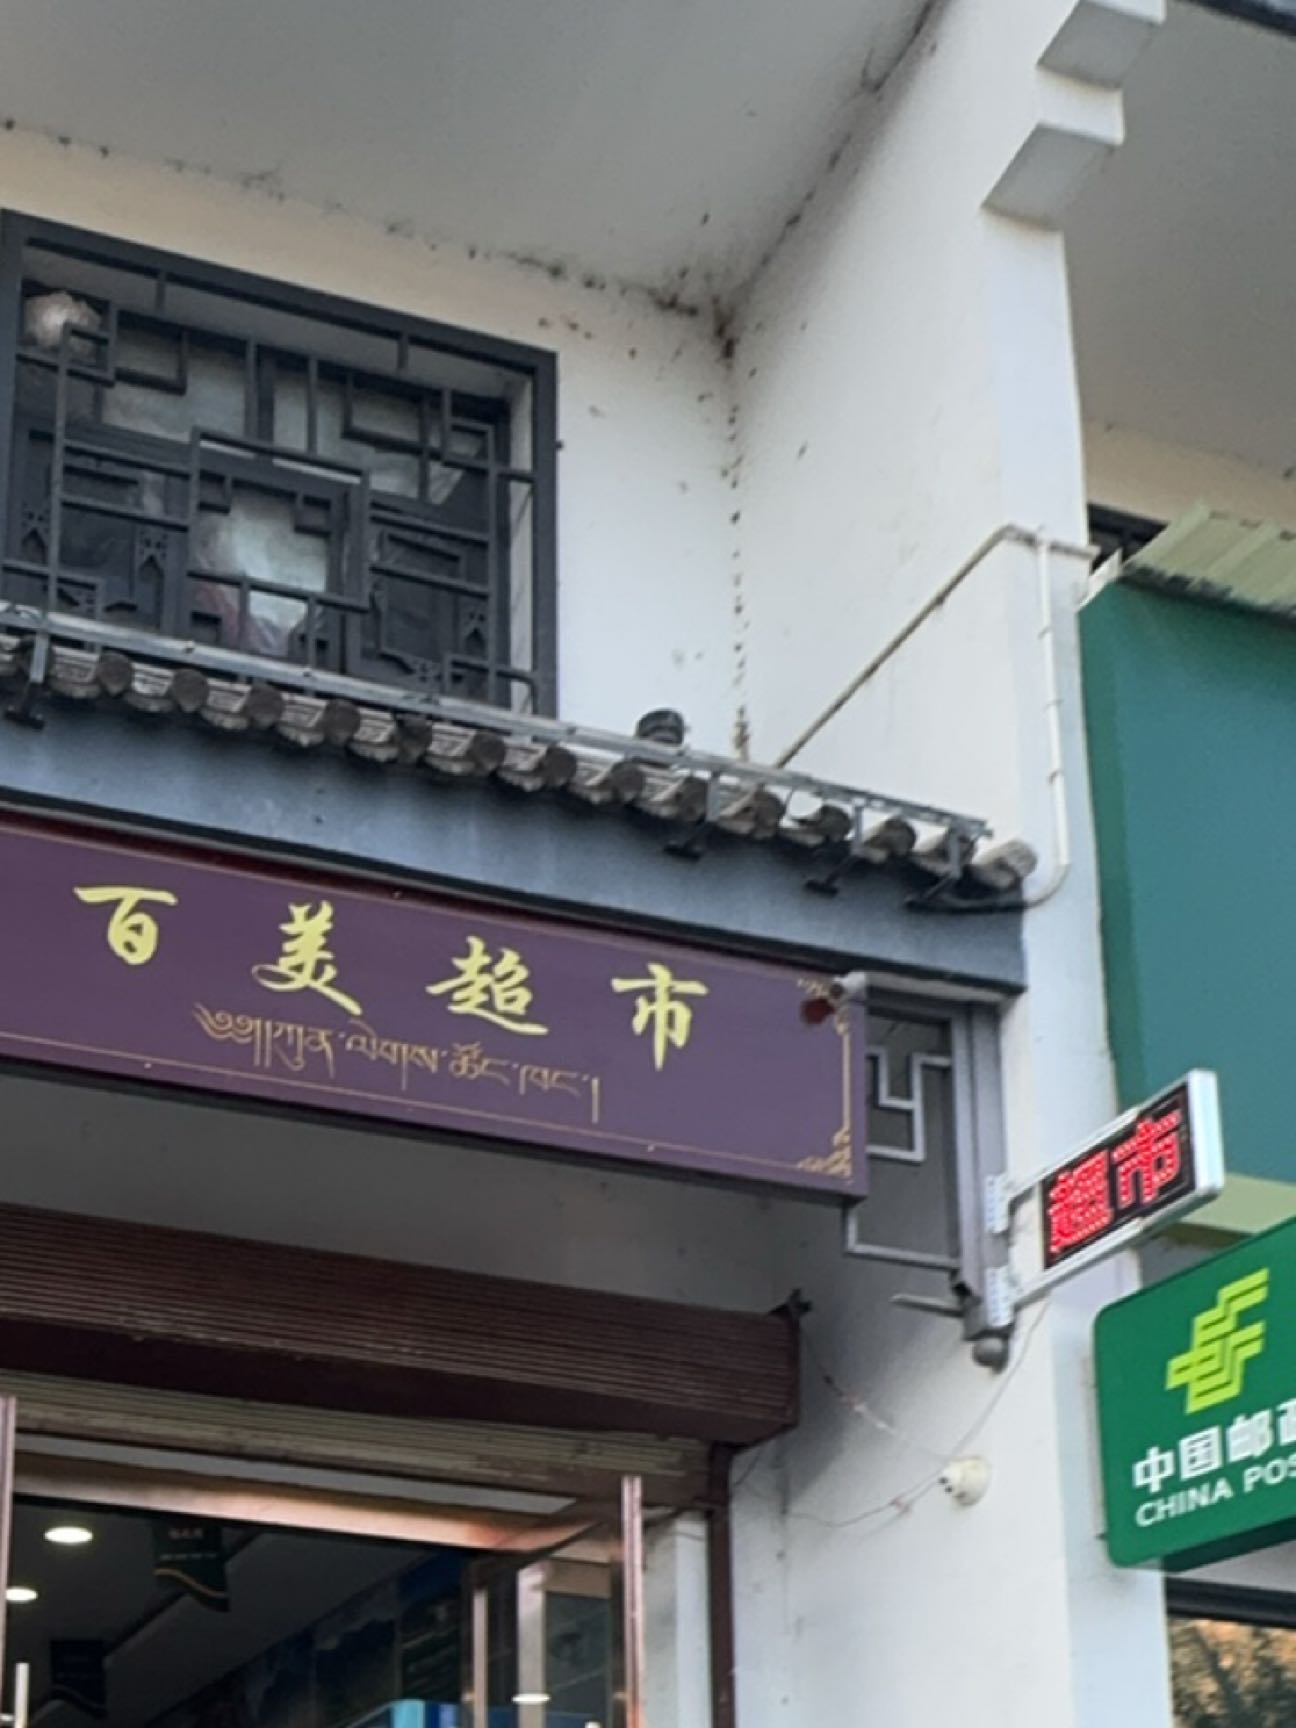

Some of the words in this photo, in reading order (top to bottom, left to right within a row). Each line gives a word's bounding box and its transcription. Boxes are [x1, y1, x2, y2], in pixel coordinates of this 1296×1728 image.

[74, 886, 708, 1071] 百美超市
[1048, 1110, 1183, 1254] 超市
[1136, 1477, 1234, 1527] CHINA
